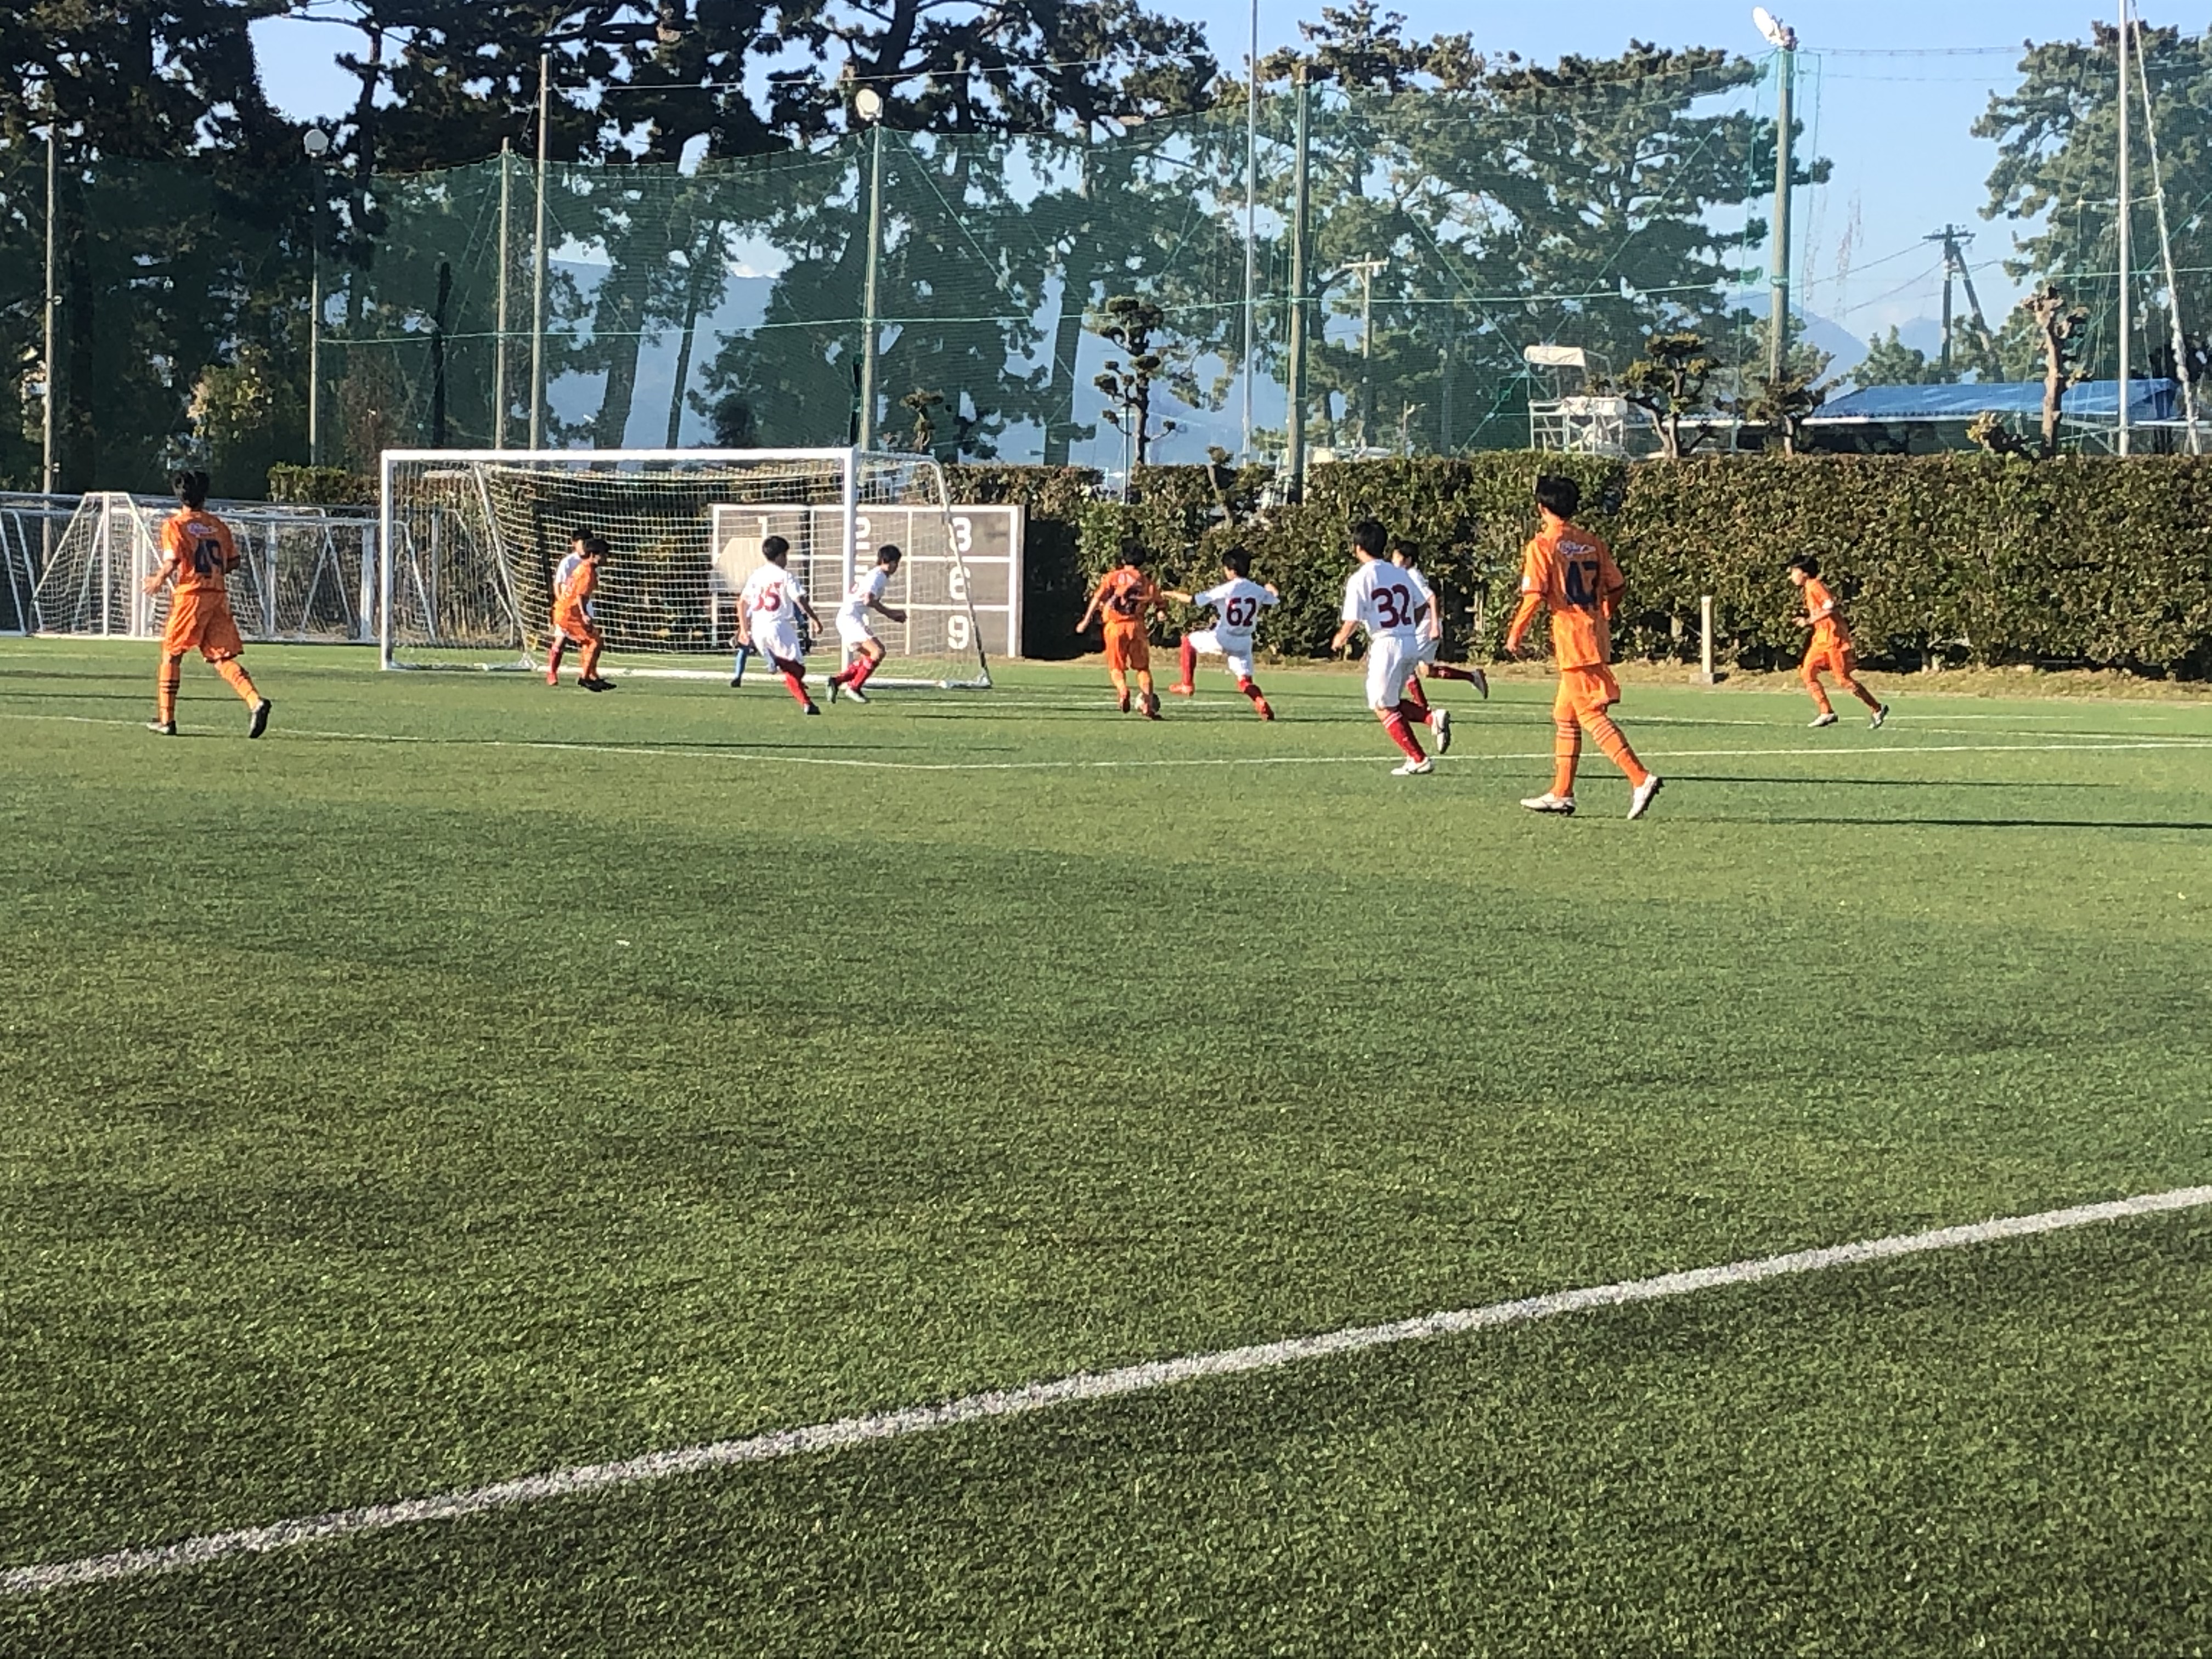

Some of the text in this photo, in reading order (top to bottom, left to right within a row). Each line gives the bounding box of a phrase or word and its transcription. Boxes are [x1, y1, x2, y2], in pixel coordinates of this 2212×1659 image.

[949, 517, 972, 552] 3
[949, 566, 970, 600] 6
[1226, 597, 1256, 627] 62
[1372, 583, 1412, 629] 32
[948, 615, 969, 650] 9
